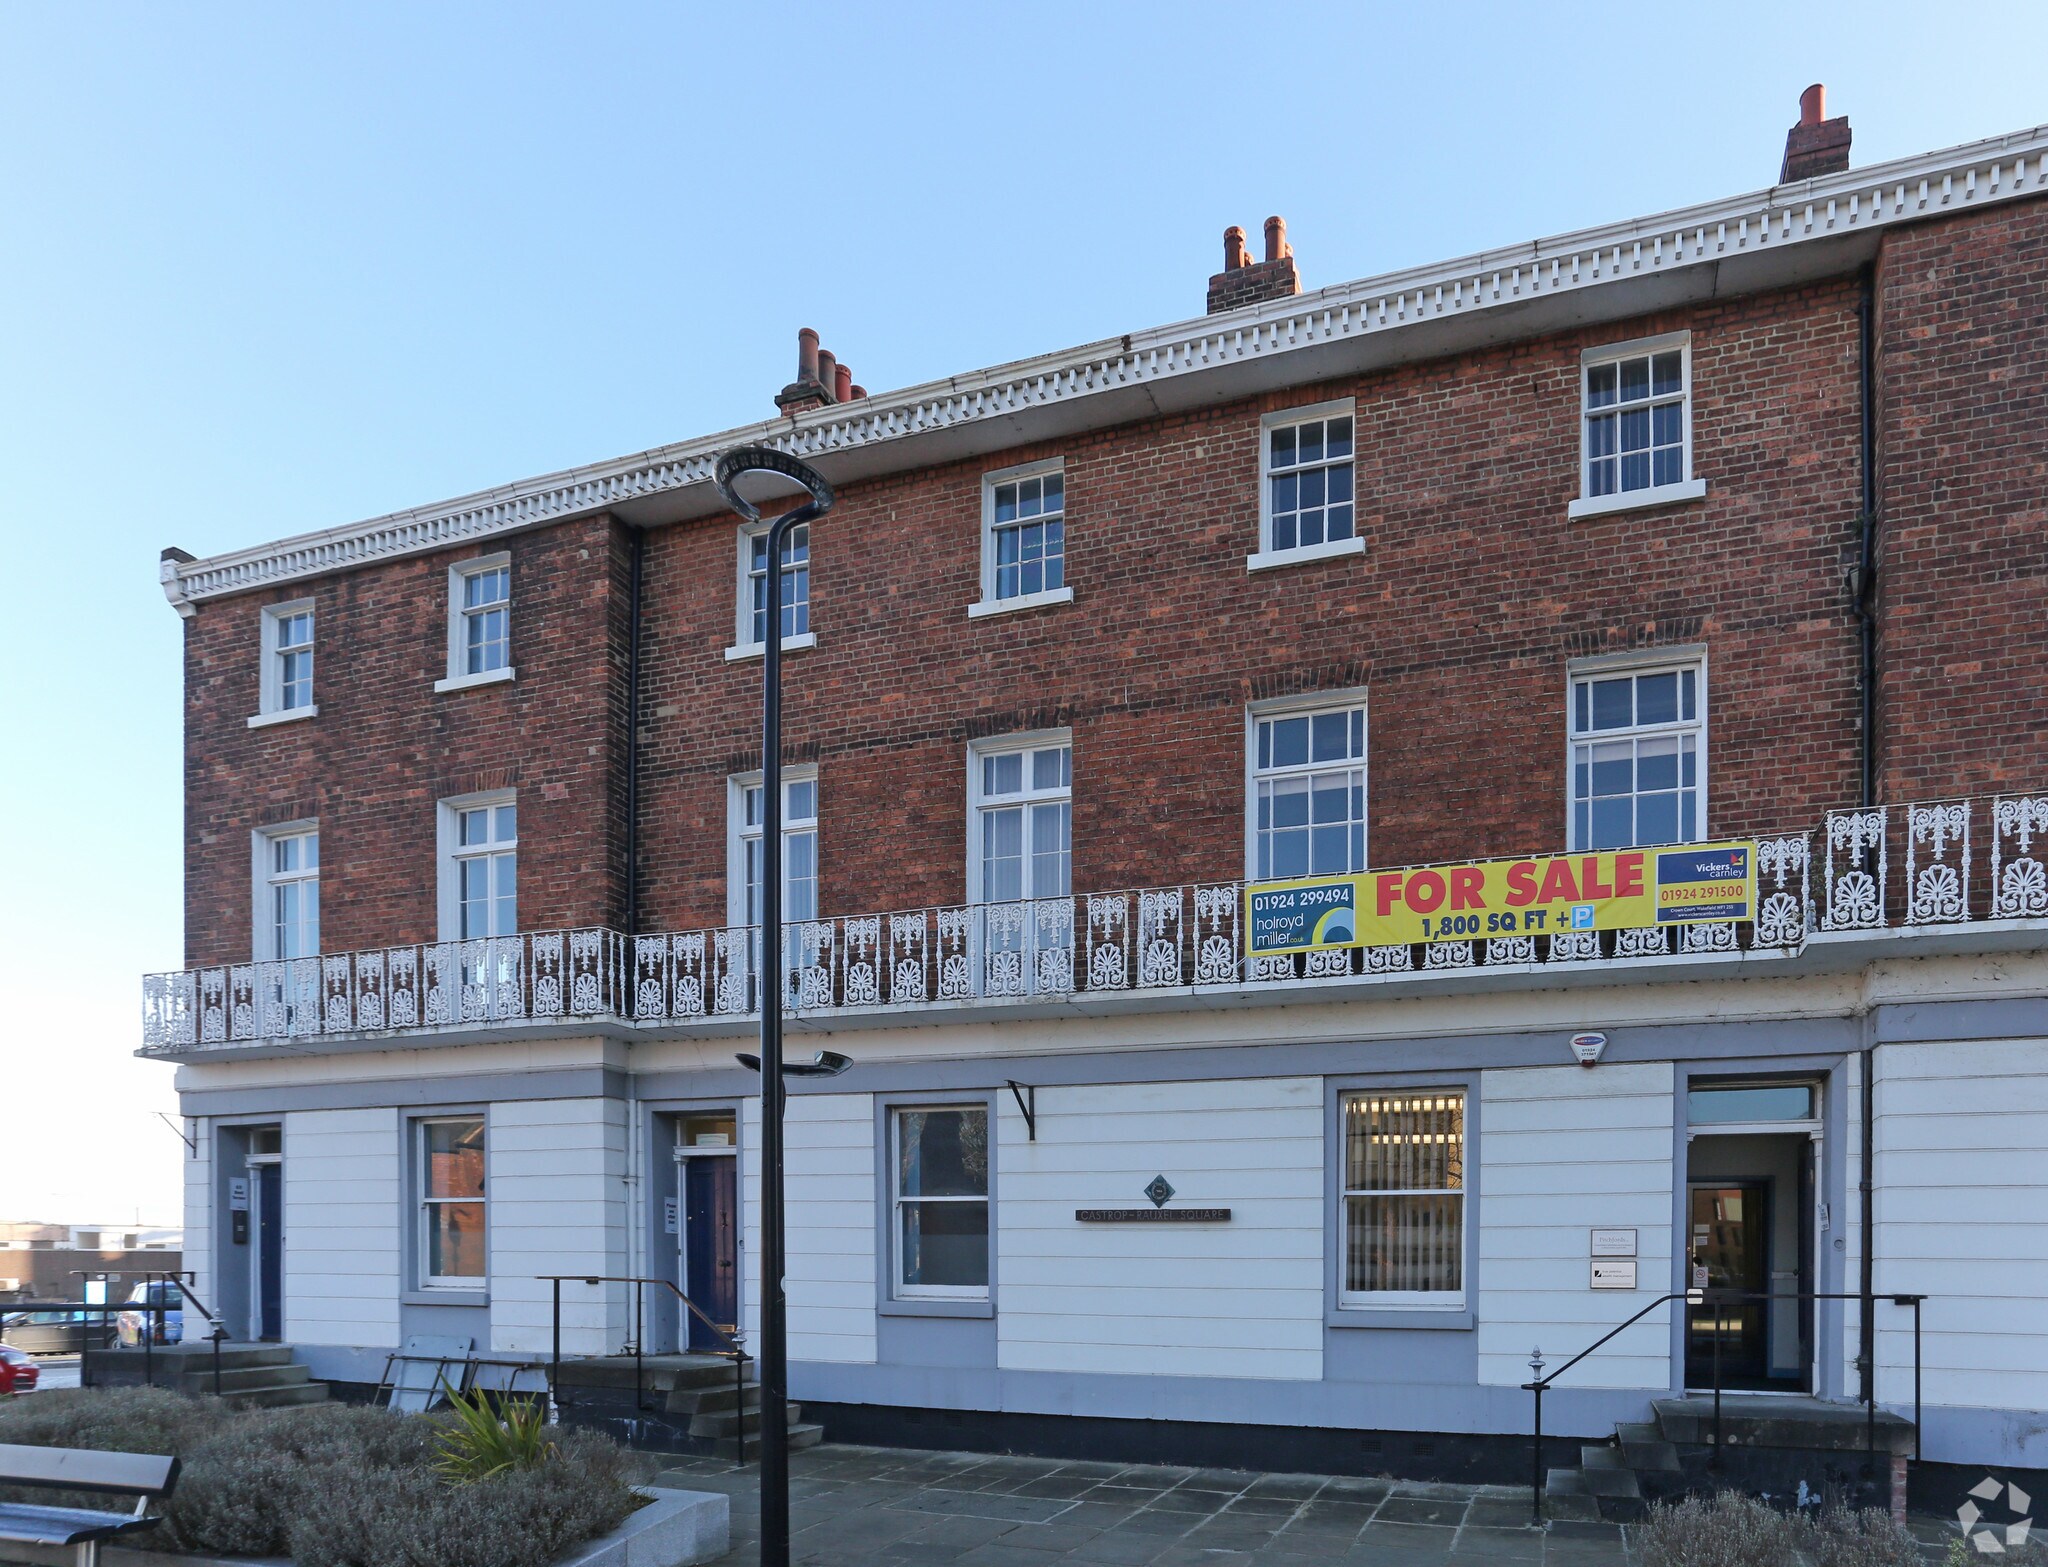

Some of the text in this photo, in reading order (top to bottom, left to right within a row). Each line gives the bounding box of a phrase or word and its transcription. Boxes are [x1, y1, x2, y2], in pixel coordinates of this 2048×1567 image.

[1696, 863, 1730, 872] Vickers
[1709, 868, 1744, 878] carnley
[1376, 852, 1645, 917] FOR SALE
[1661, 885, 1743, 901] 01924 291500
[1254, 888, 1349, 911] 01924 299494
[1256, 913, 1304, 931] holroyd
[1420, 914, 1480, 941] 1,800
[1487, 911, 1518, 933] SQ
[1524, 910, 1547, 930] FT
[1179, 1209, 1225, 1220] SQUARE
